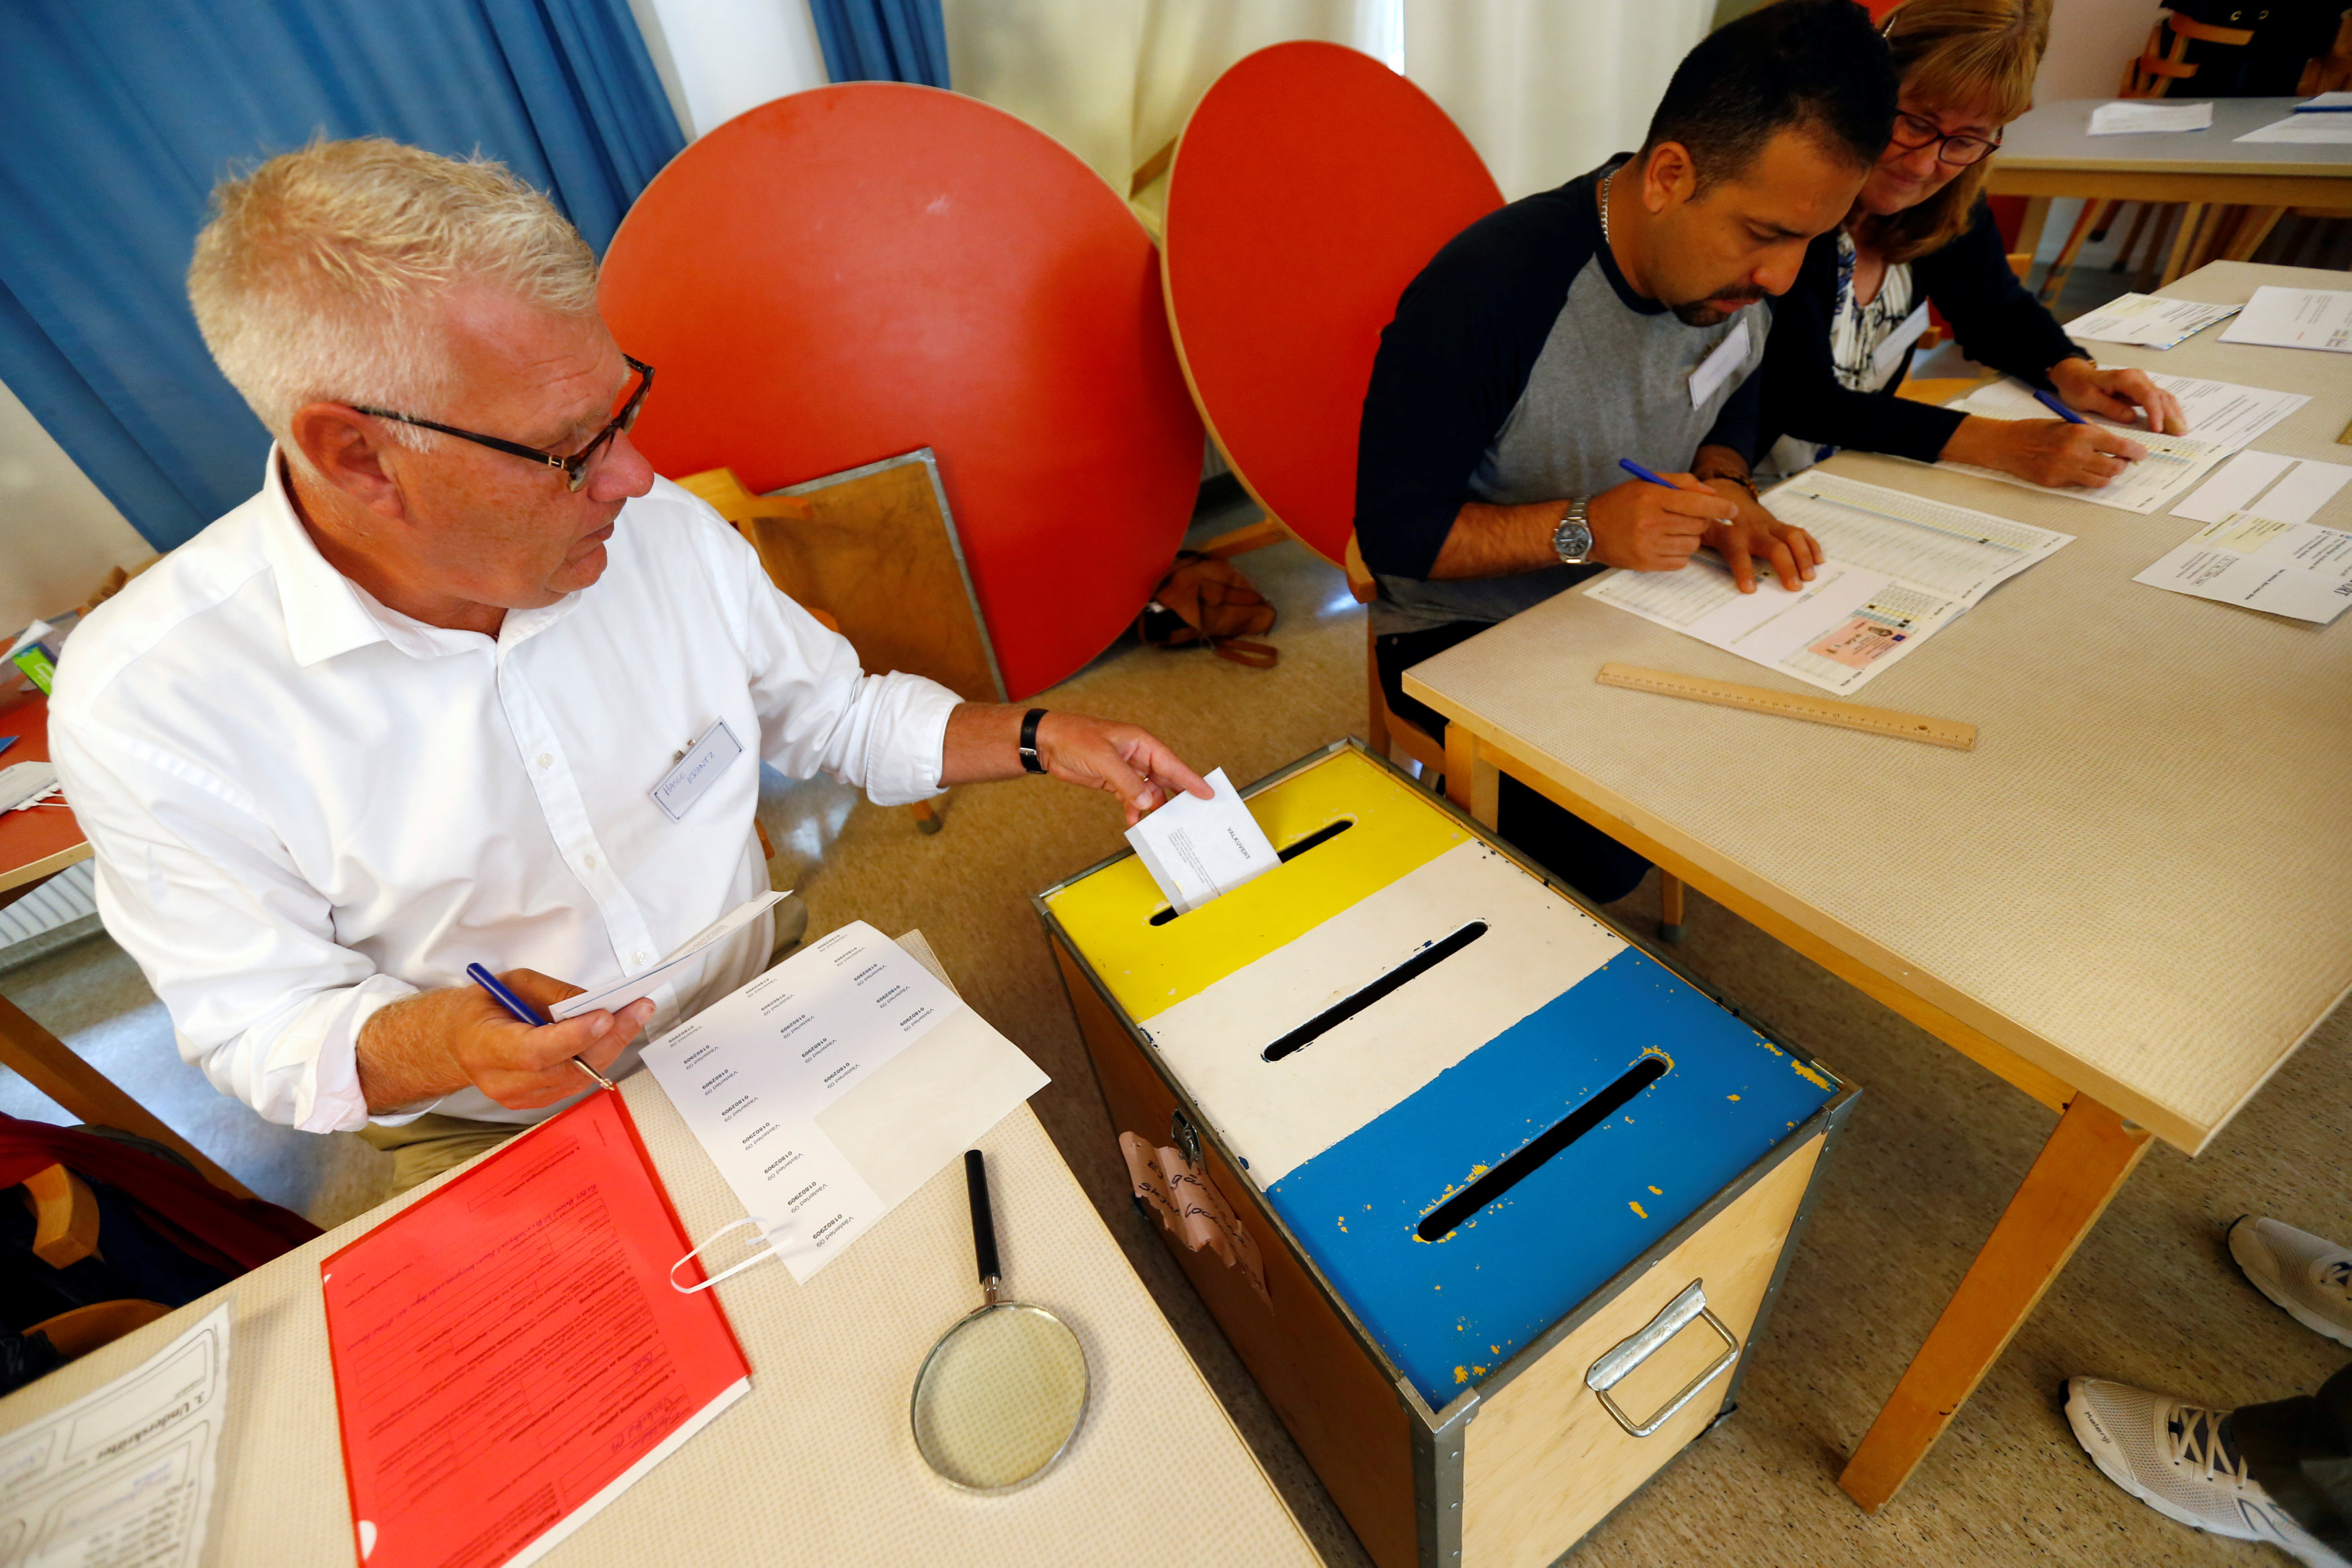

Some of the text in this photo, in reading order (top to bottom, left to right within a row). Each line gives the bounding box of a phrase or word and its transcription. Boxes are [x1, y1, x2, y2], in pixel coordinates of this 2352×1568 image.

[1227, 826, 1251, 860] VALKUVERT
[854, 964, 877, 981] 01802909
[761, 994, 786, 1010] 01802909
[876, 986, 900, 1002] 01802909
[781, 1014, 805, 1033] 01802909
[900, 1008, 924, 1026] 01802909
[684, 1045, 709, 1063] 01802909
[802, 1038, 827, 1057] 01802909
[702, 1070, 728, 1089] 01802909
[825, 1063, 849, 1082] 01802909
[722, 1096, 748, 1115] 01802909
[743, 1123, 769, 1143] 01802909
[765, 1151, 792, 1174] 01802909
[788, 1182, 816, 1205] 01802909
[813, 1215, 842, 1239] 01802909
[578, 1269, 625, 1305] Röstmottagning
